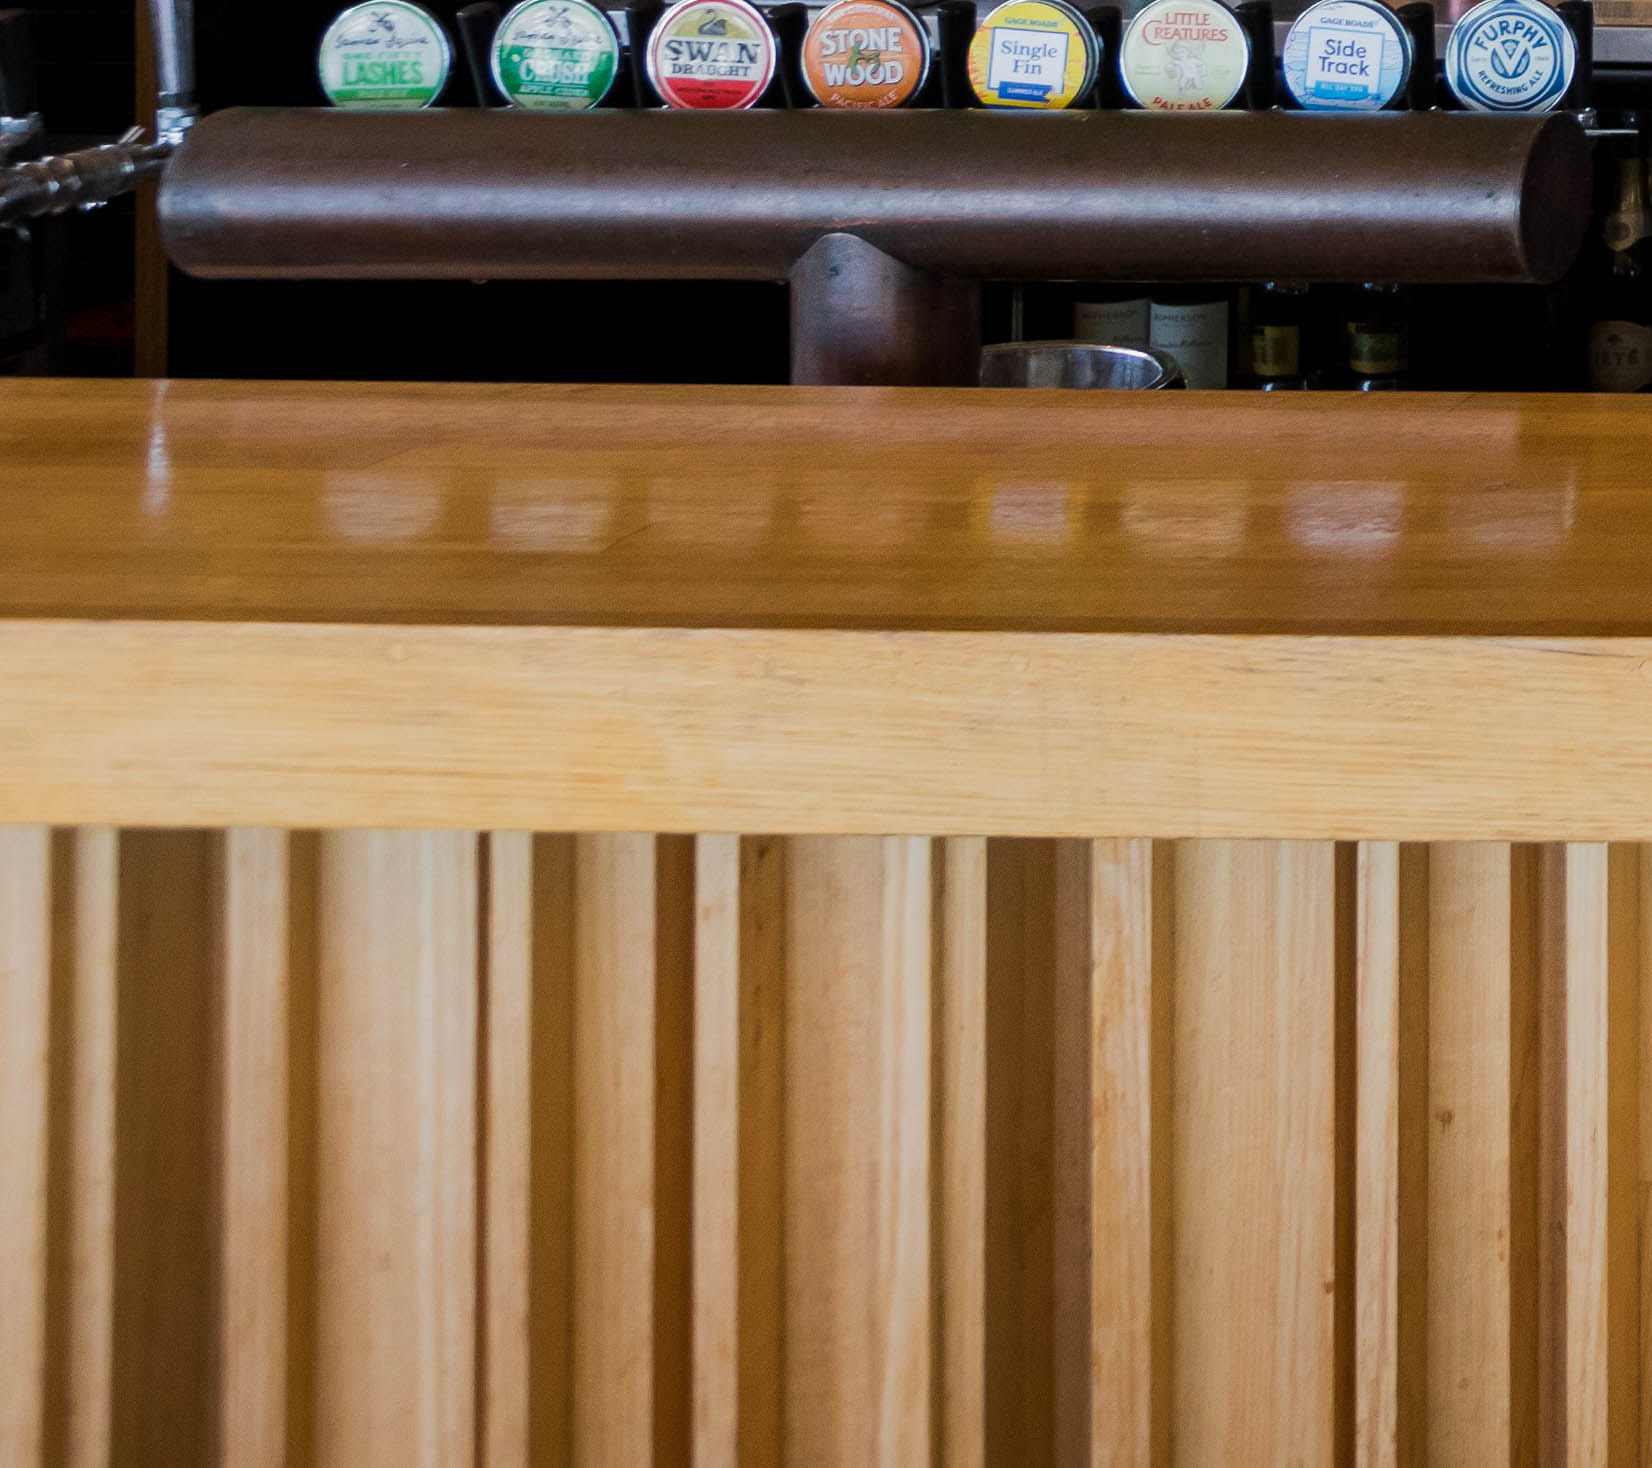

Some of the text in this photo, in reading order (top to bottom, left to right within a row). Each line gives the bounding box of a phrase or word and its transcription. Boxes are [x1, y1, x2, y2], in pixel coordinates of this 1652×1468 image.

[1165, 12, 1211, 25] LITTLE
[820, 27, 903, 56] STONE
[1142, 20, 1229, 45] CREATURES
[1474, 19, 1548, 50] FURPHY
[664, 39, 760, 64] SWAN
[1001, 40, 1058, 59] Single
[1325, 37, 1367, 57] Side
[343, 61, 423, 86] LASHES
[521, 61, 589, 82] CRUSH
[671, 63, 750, 77] DRAUGHT
[823, 59, 904, 87] WOOD
[1013, 60, 1042, 75] Fin
[1318, 54, 1369, 77] Track
[1477, 68, 1544, 95] REFRESHING ALE
[1185, 97, 1212, 110] ALE
